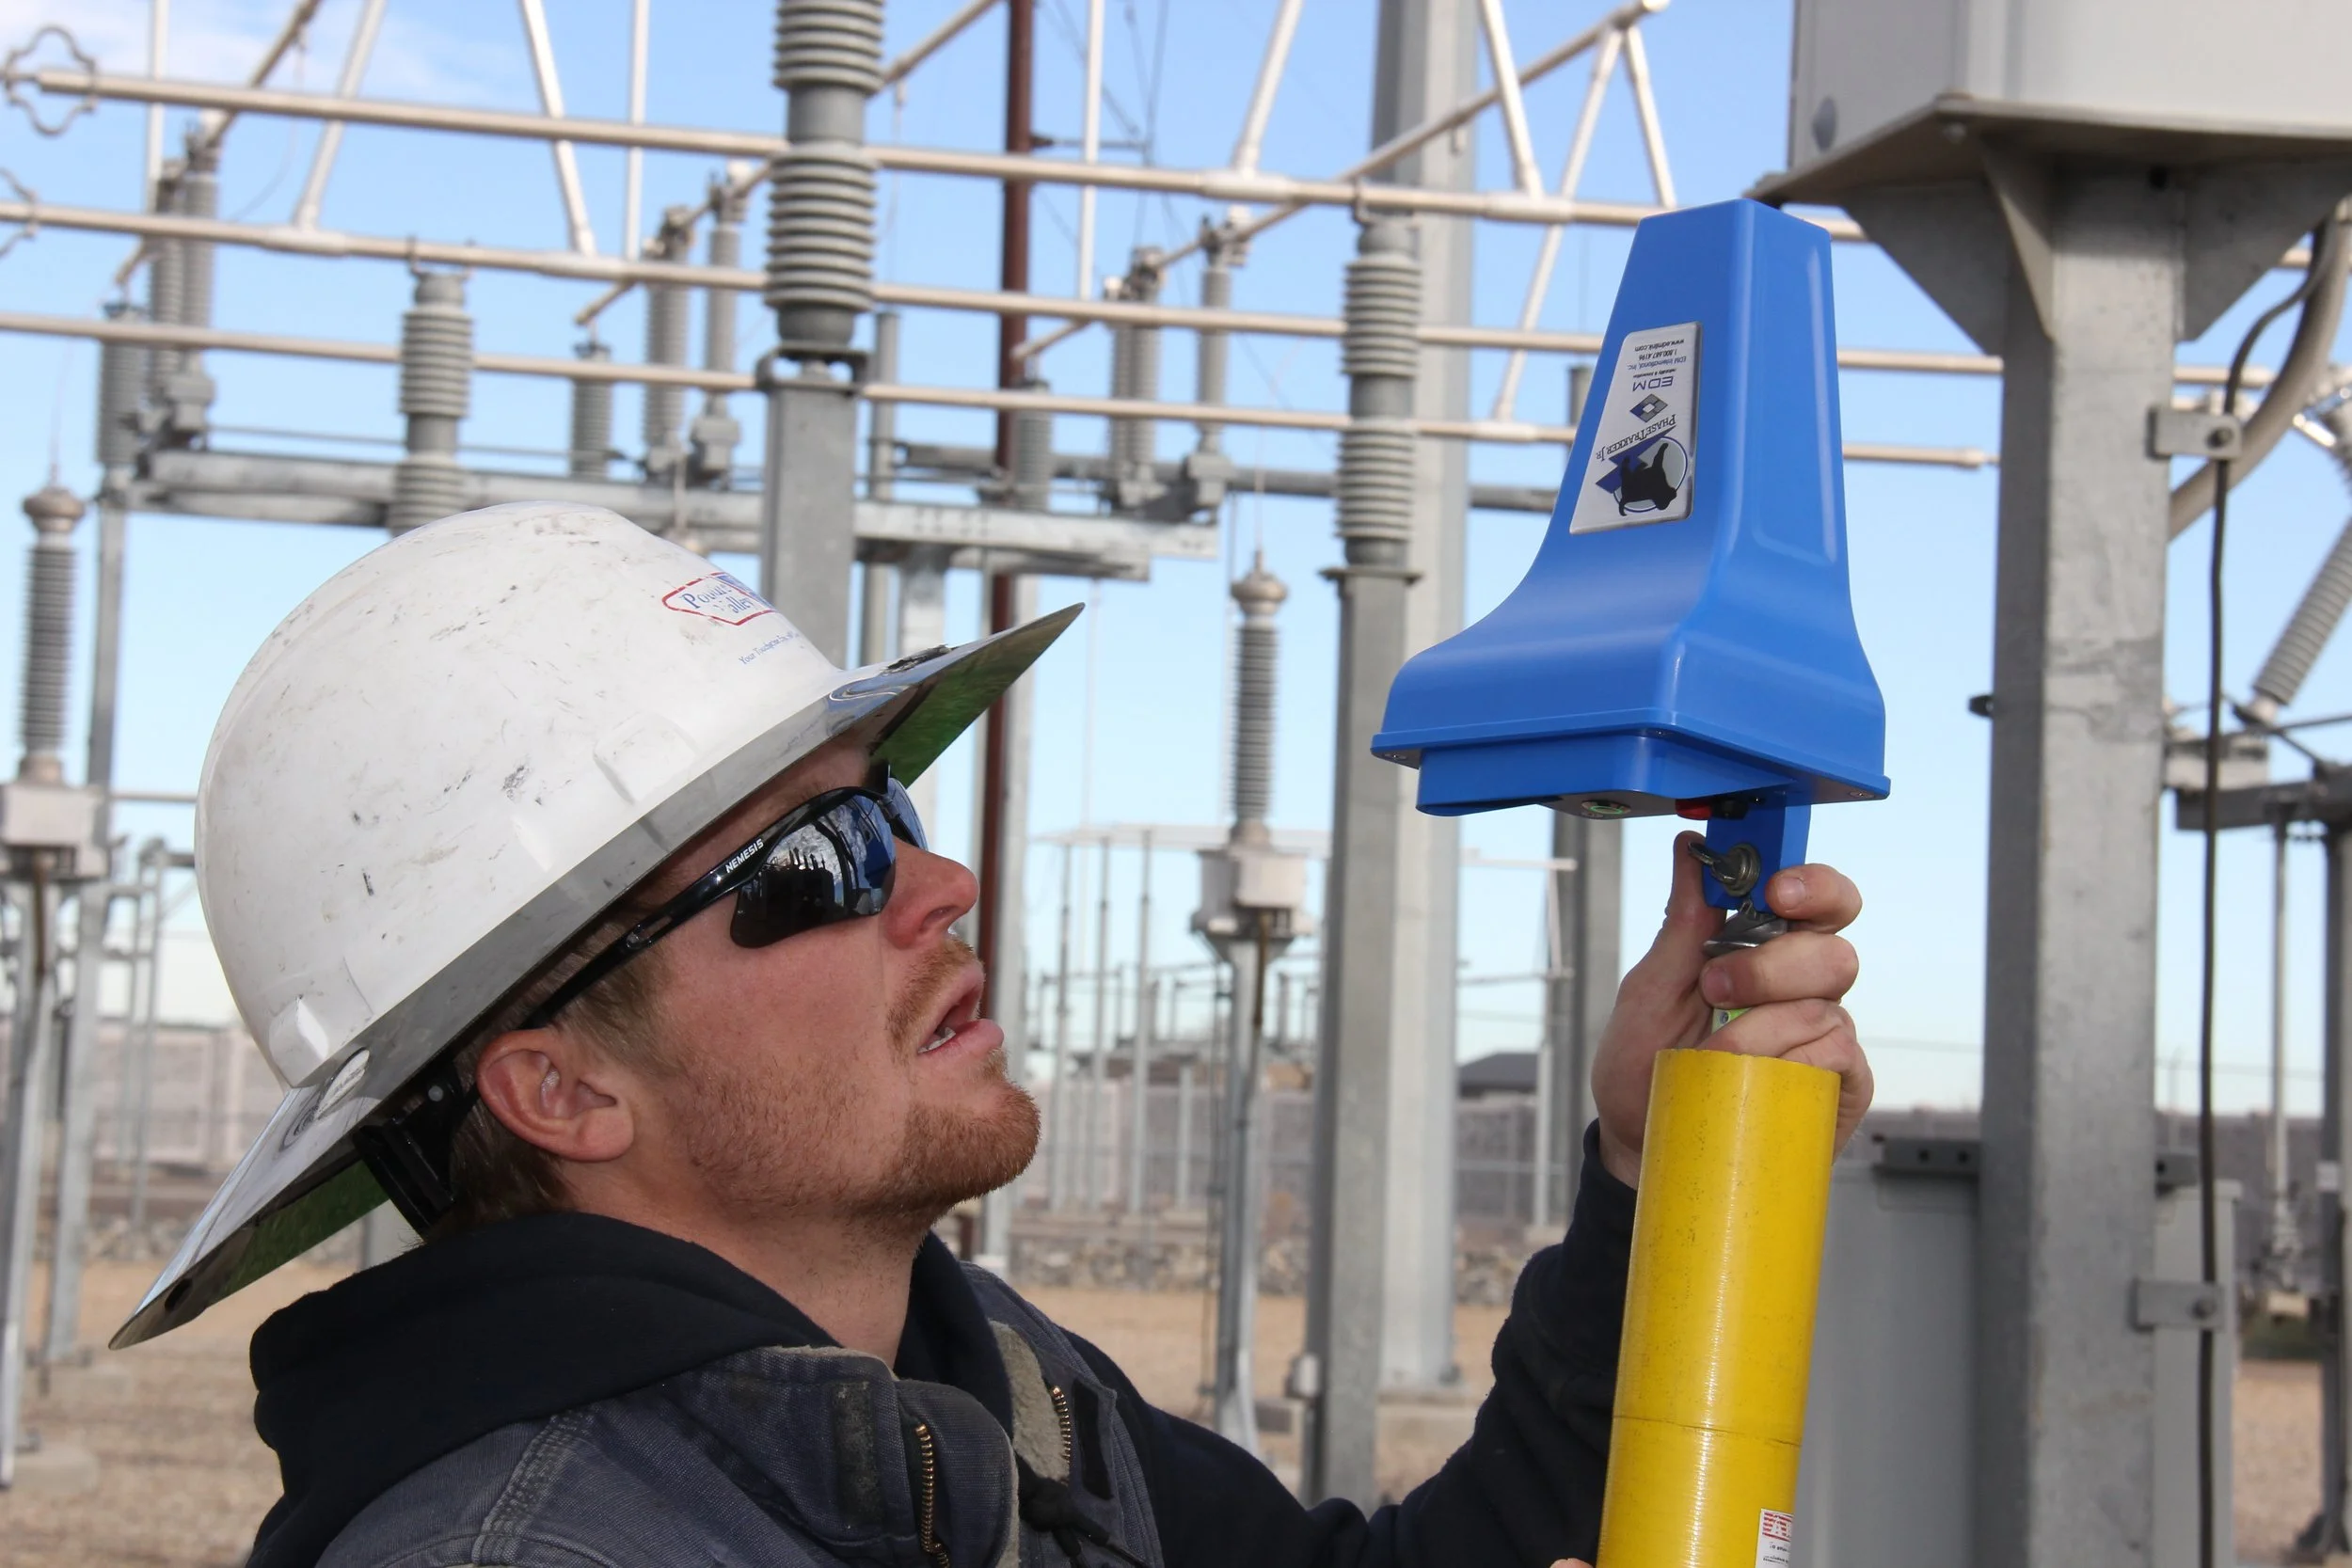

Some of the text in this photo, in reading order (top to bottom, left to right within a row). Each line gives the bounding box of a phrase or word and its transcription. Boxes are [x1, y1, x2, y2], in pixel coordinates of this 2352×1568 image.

[1674, 356, 1687, 364] EDM
[1632, 375, 1674, 392] EDM
[724, 838, 764, 873] NEMESIS
